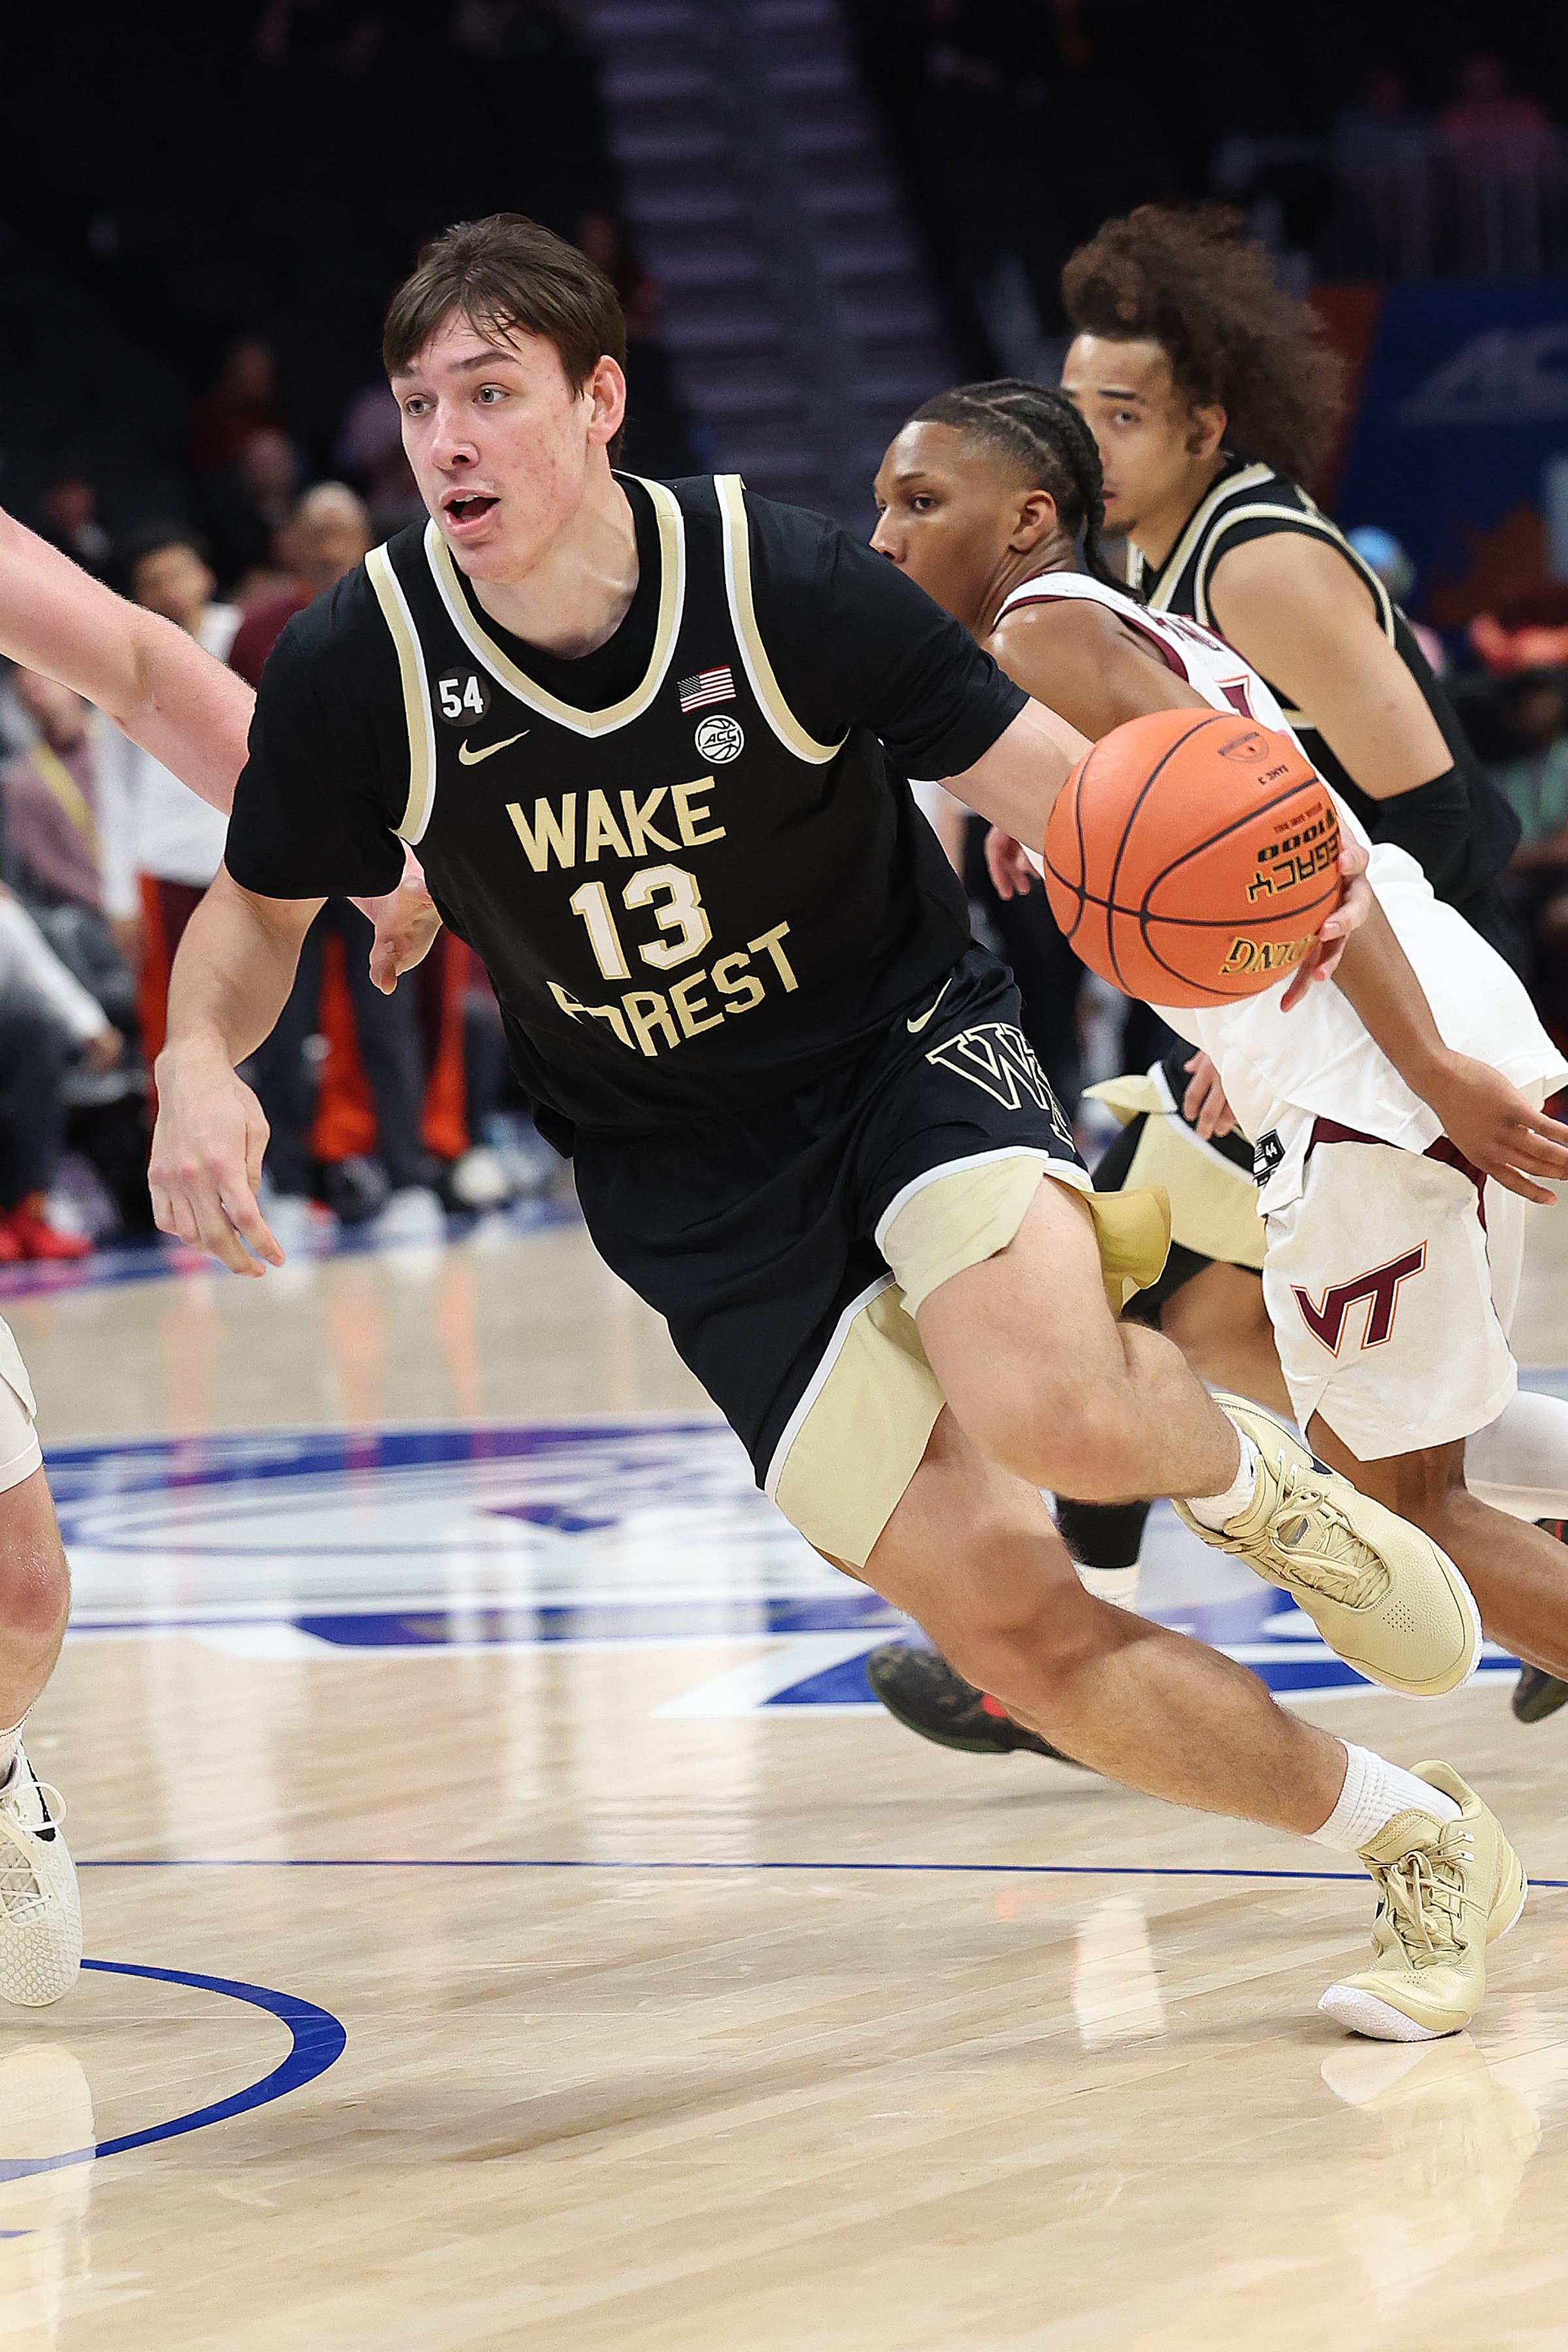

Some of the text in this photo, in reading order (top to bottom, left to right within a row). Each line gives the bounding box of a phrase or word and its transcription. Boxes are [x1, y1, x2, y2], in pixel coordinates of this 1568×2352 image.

[439, 676, 484, 718] 54
[505, 776, 727, 873] WAKE
[1246, 830, 1339, 904] EGACY
[570, 864, 713, 981] 13
[1266, 1141, 1277, 1158] 44
[1290, 1239, 1428, 1359] VT
